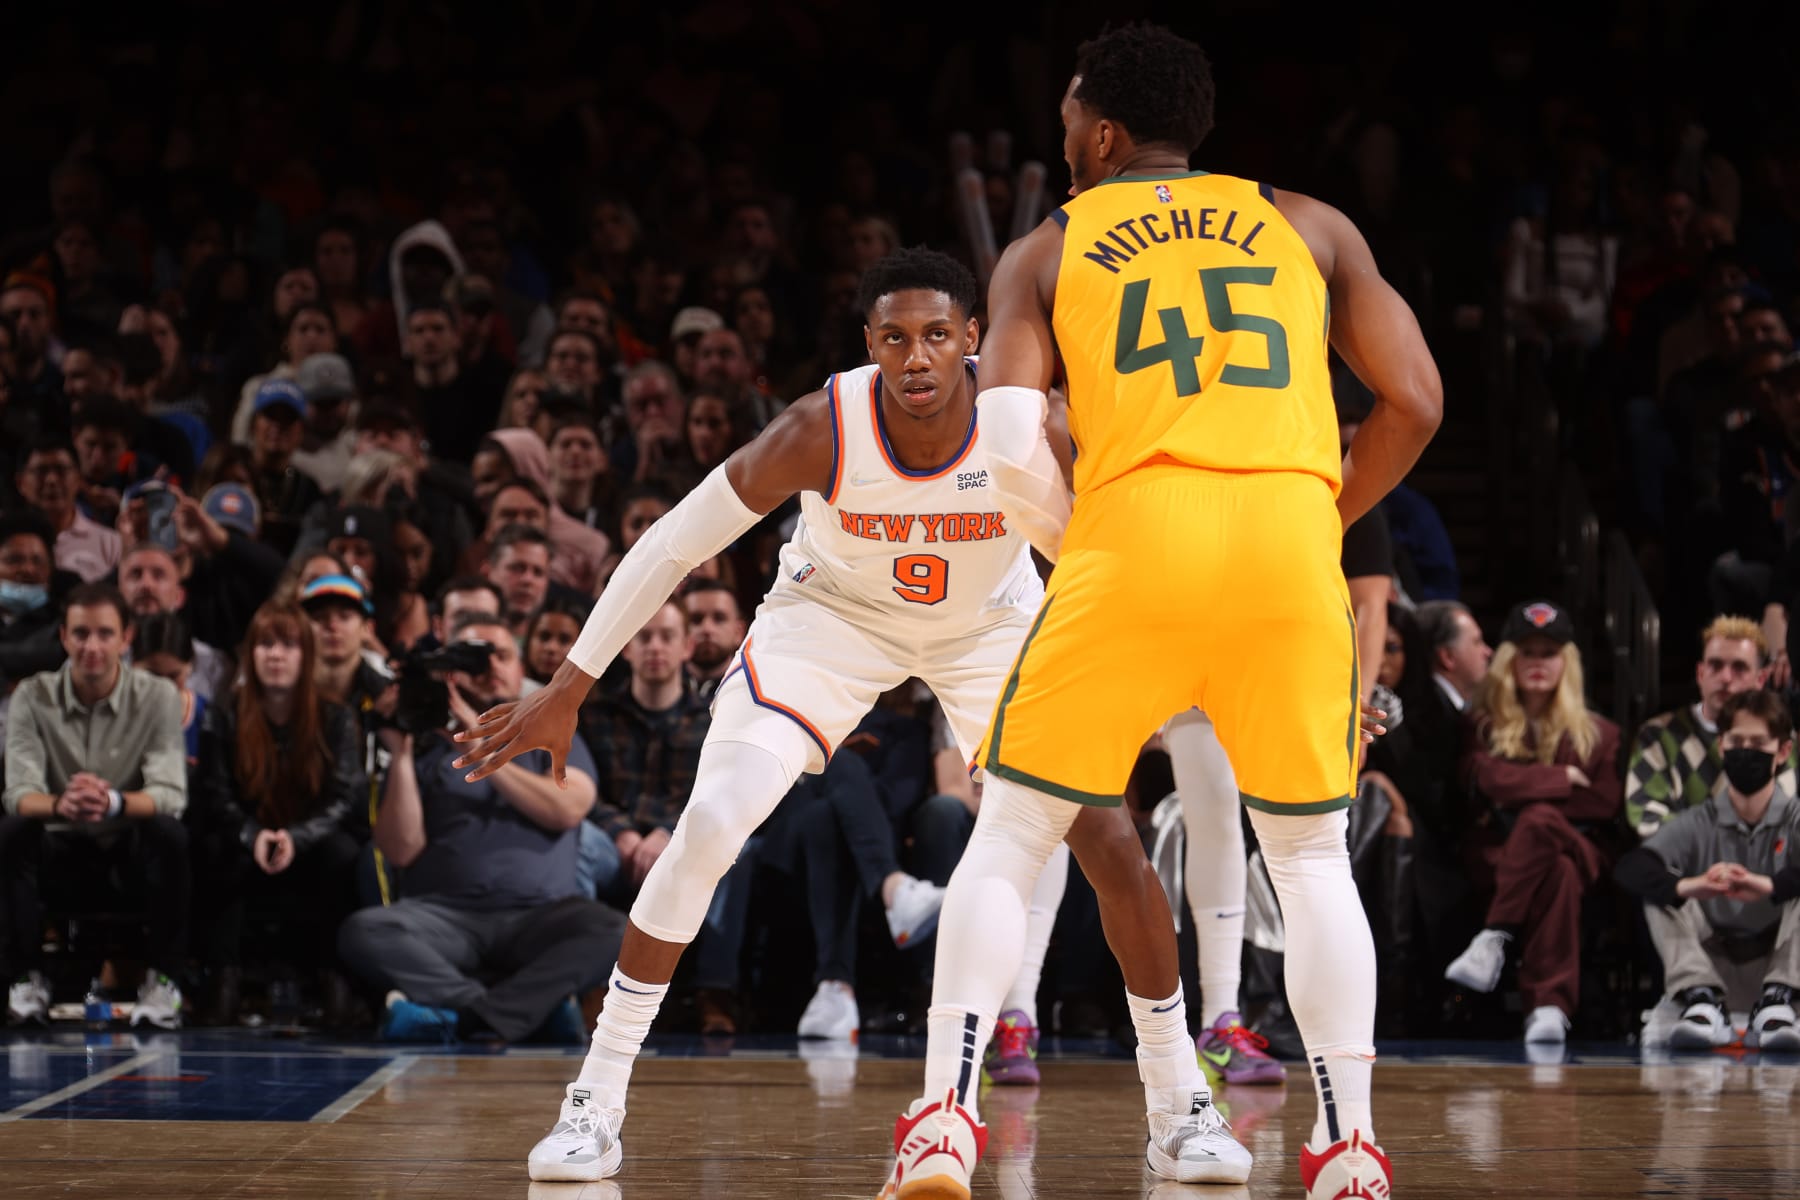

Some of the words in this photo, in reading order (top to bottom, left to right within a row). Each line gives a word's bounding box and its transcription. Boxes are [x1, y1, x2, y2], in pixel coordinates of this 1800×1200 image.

[1083, 208, 1266, 274] MITCHELL
[1114, 266, 1291, 398] 45
[957, 470, 988, 482] SQUA
[957, 479, 988, 491] SPAC
[838, 509, 915, 543] NEW
[919, 511, 1007, 543] YORK
[892, 554, 949, 606] 9
